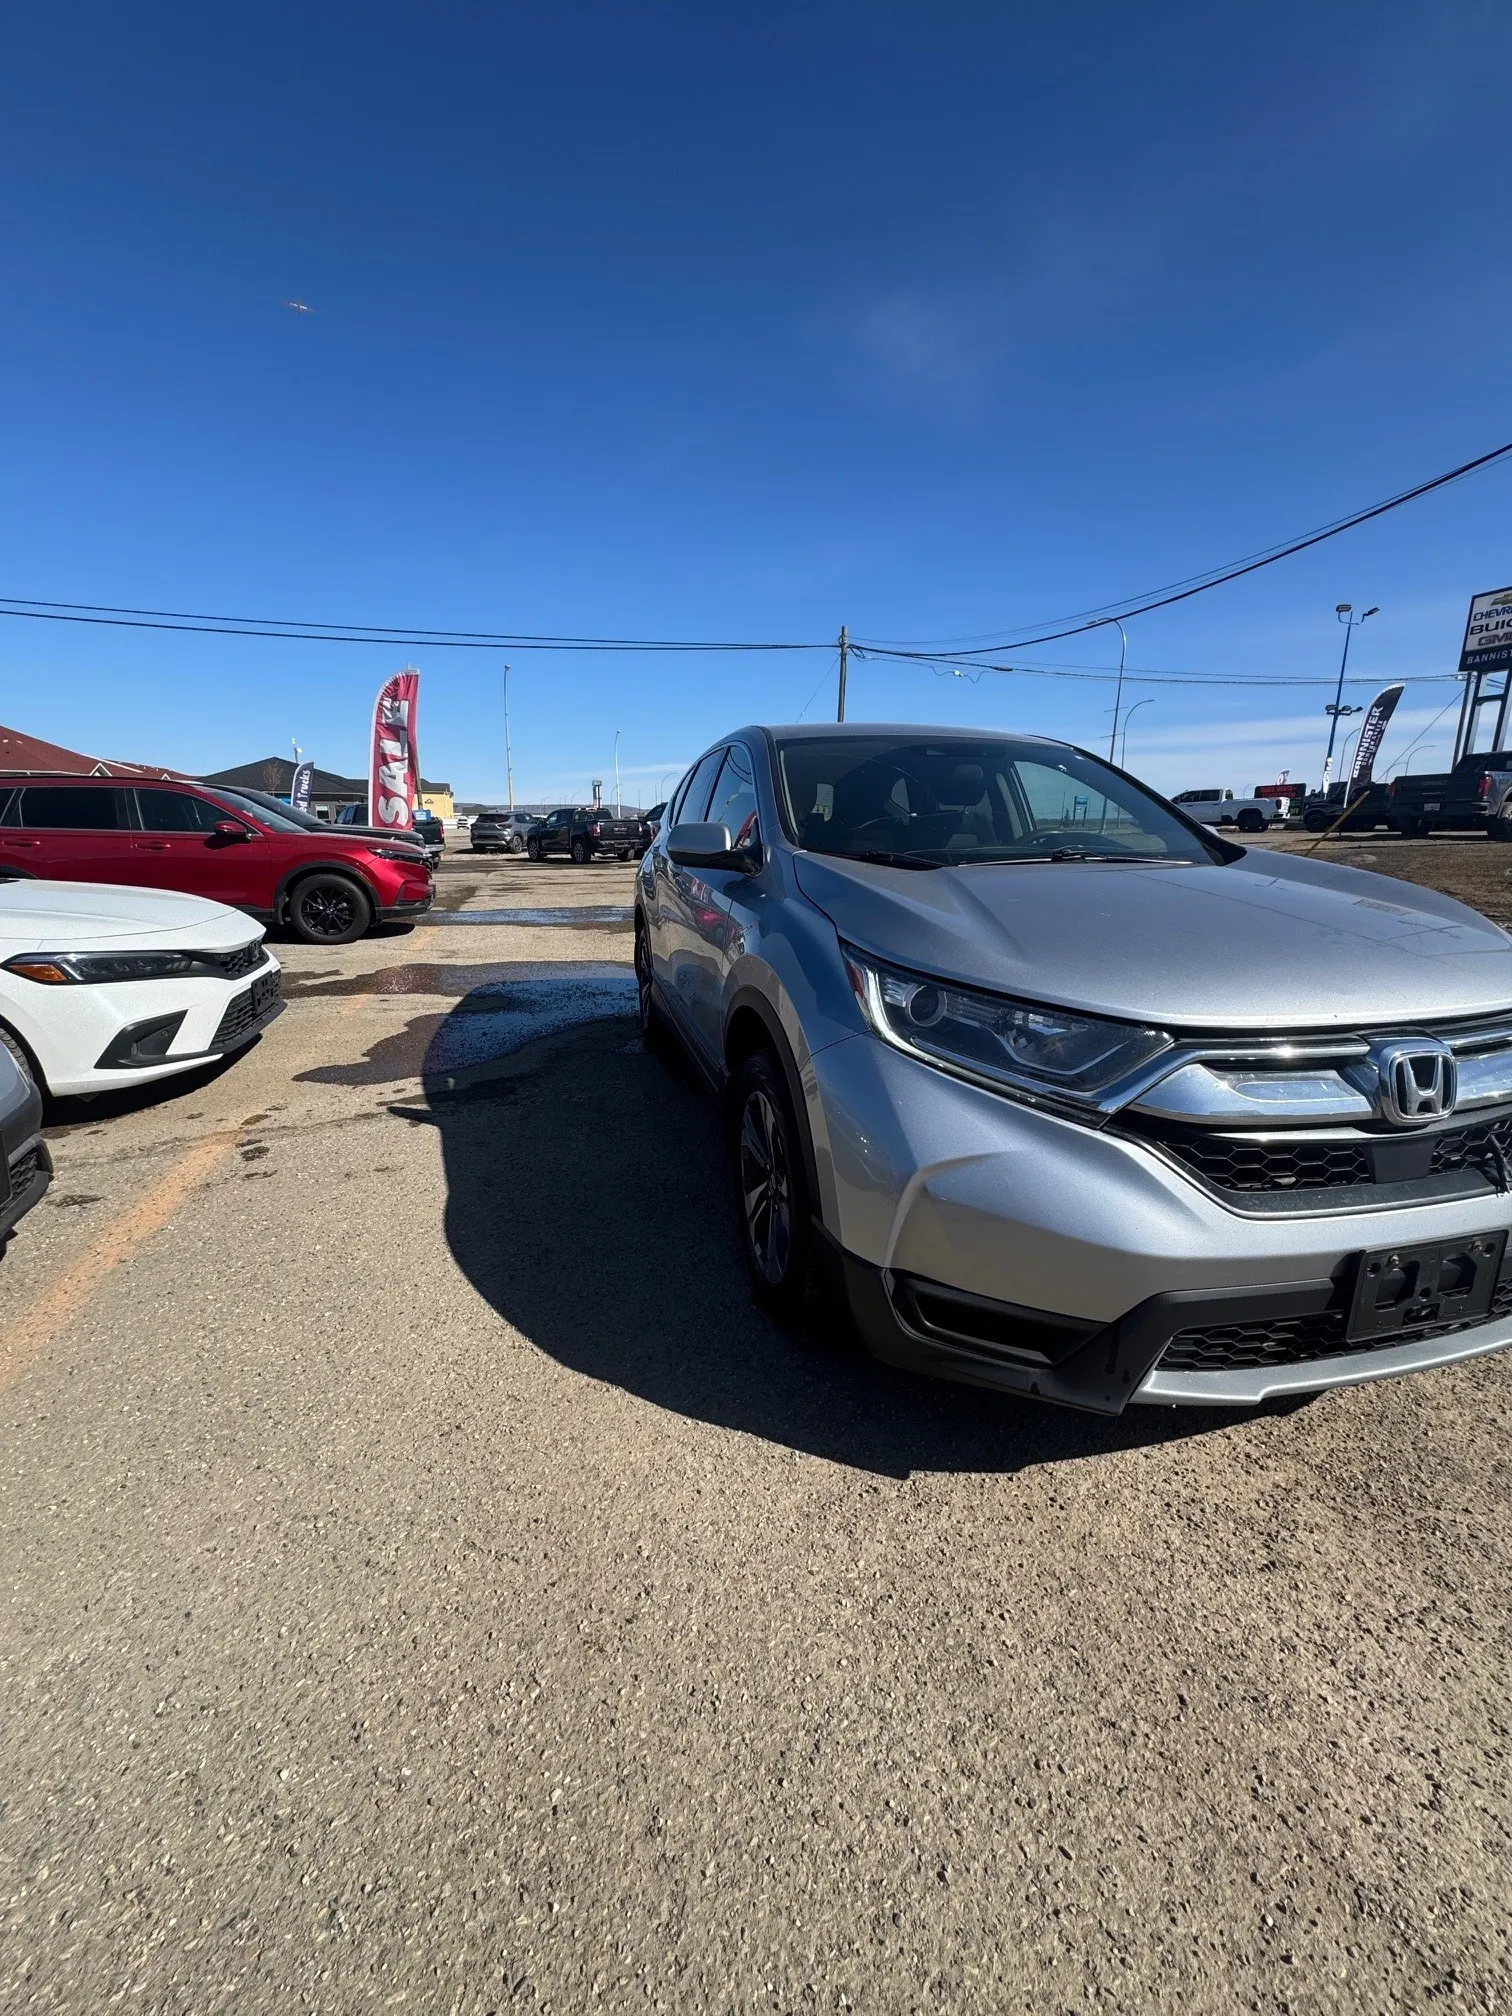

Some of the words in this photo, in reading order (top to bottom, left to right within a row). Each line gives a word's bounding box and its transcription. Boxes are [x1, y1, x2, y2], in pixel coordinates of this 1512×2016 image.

[1473, 605, 1512, 622] CHEVR
[1477, 631, 1512, 647] GM
[1352, 705, 1384, 779] BANNISTER
[378, 697, 410, 827] SALE
[297, 769, 311, 799] Trucks
